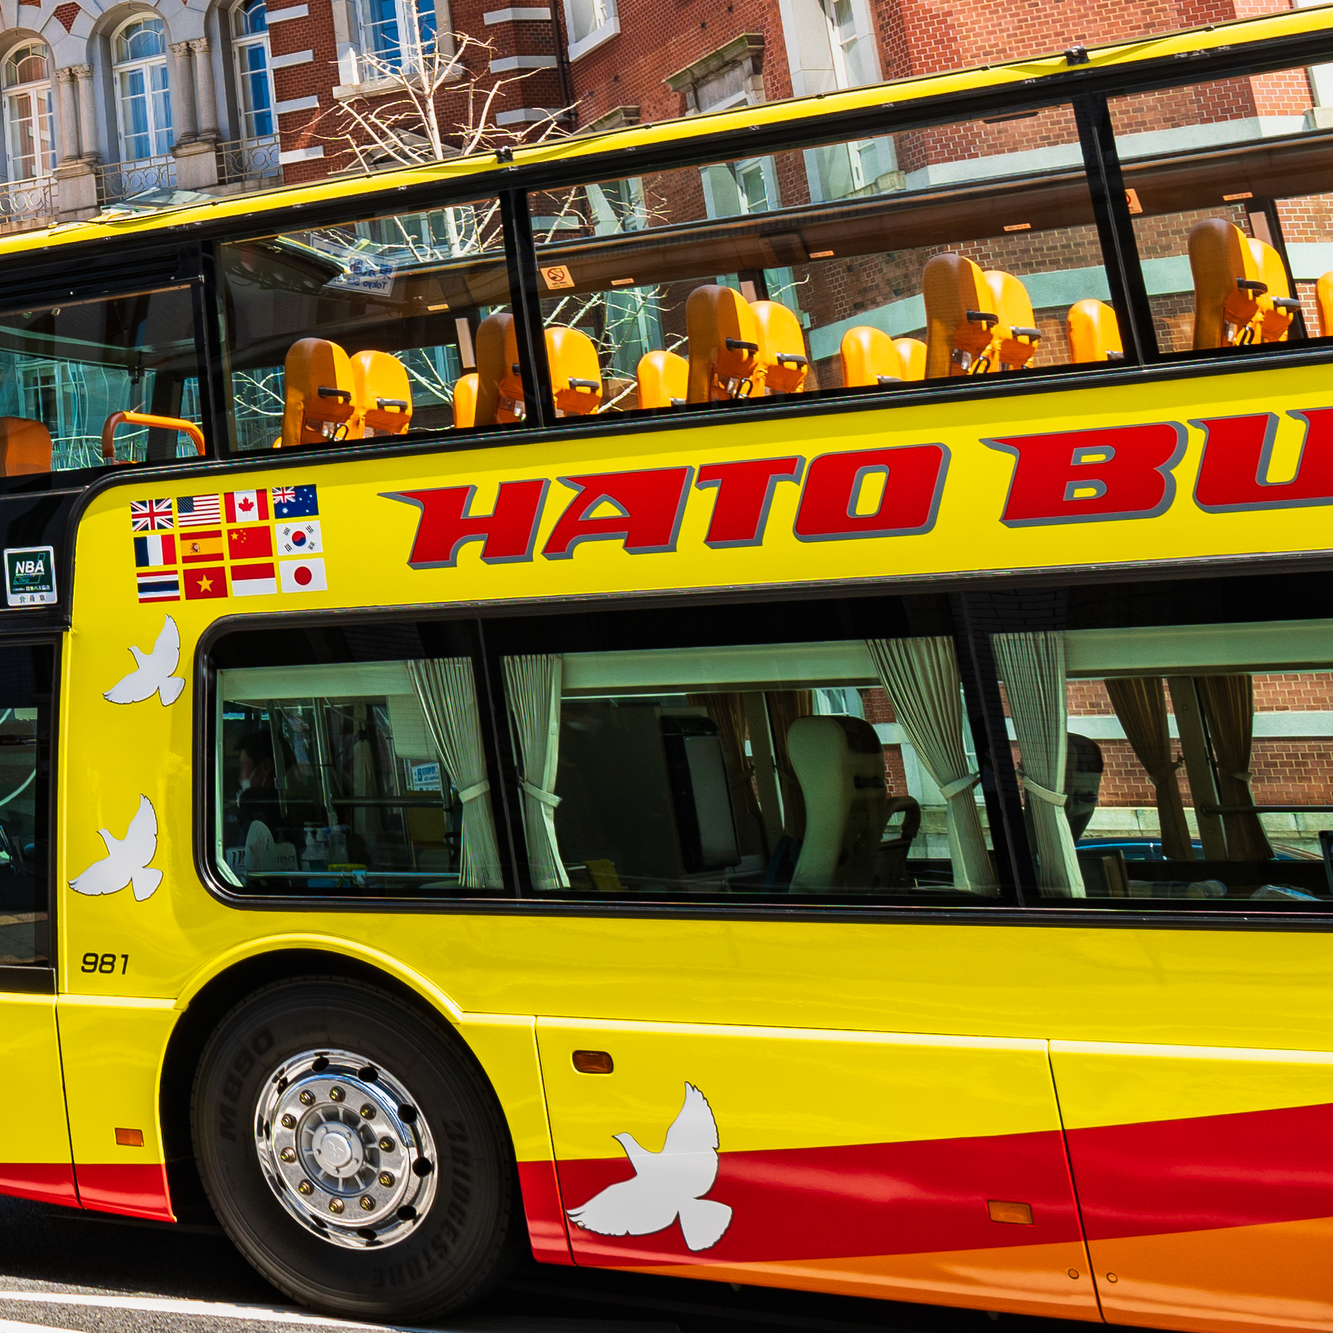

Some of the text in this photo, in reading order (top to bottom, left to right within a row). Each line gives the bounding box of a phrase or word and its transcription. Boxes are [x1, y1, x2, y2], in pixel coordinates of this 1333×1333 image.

[377, 443, 952, 569] HATO
[15, 560, 45, 574] NBA
[80, 952, 130, 975] 981
[218, 1027, 275, 1144] M890
[371, 1117, 472, 1289] BRIDGESTONE
